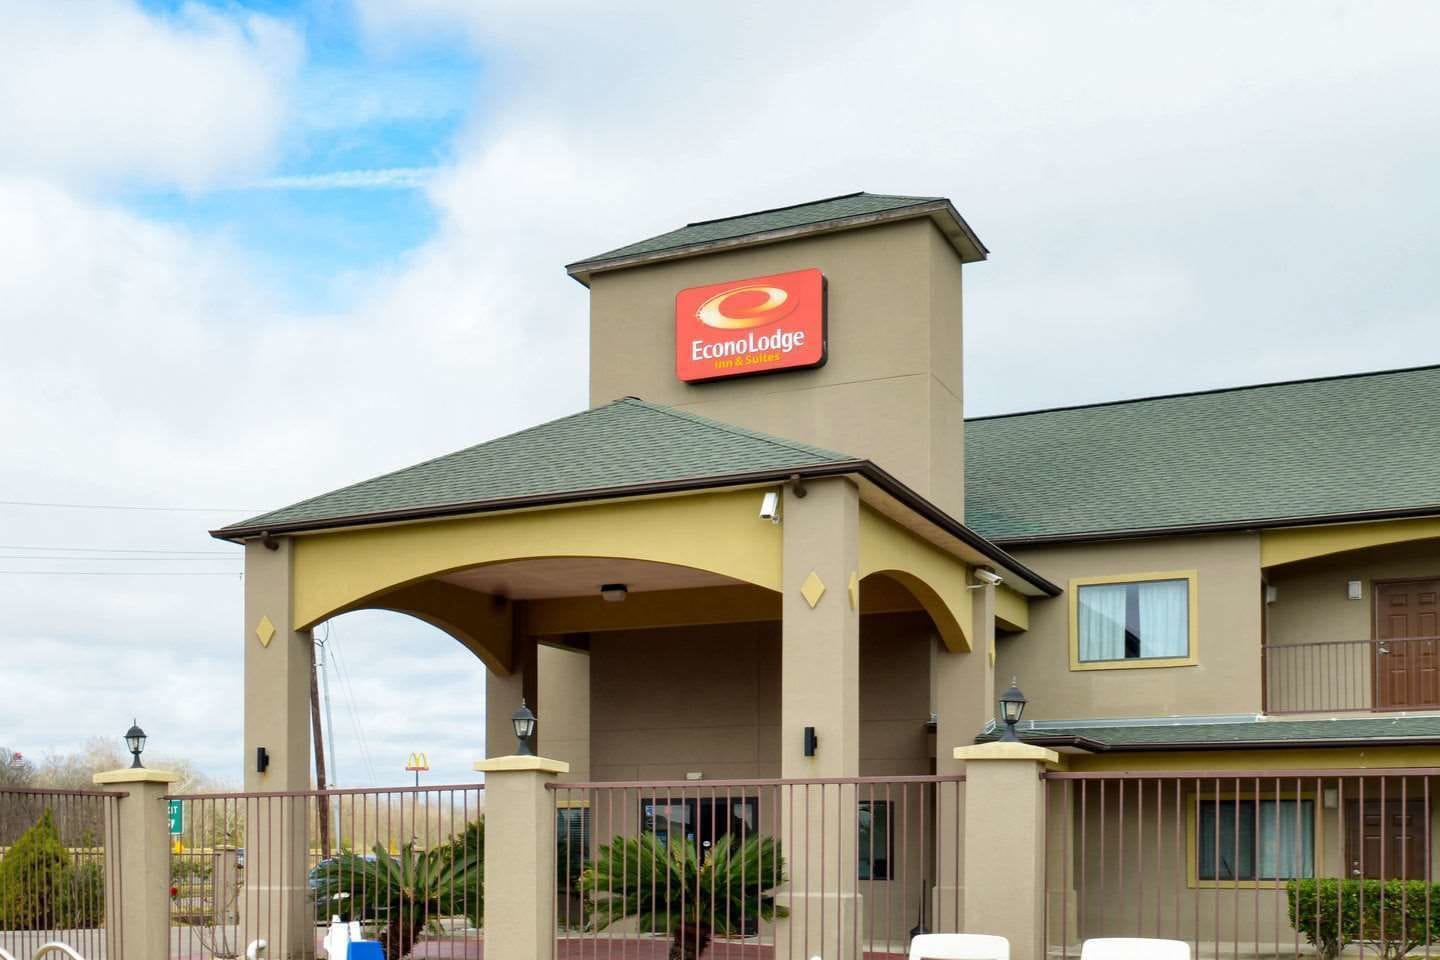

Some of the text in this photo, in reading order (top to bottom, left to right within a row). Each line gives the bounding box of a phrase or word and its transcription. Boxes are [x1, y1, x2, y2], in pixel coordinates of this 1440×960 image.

[715, 351, 781, 369] Inn & Suites
